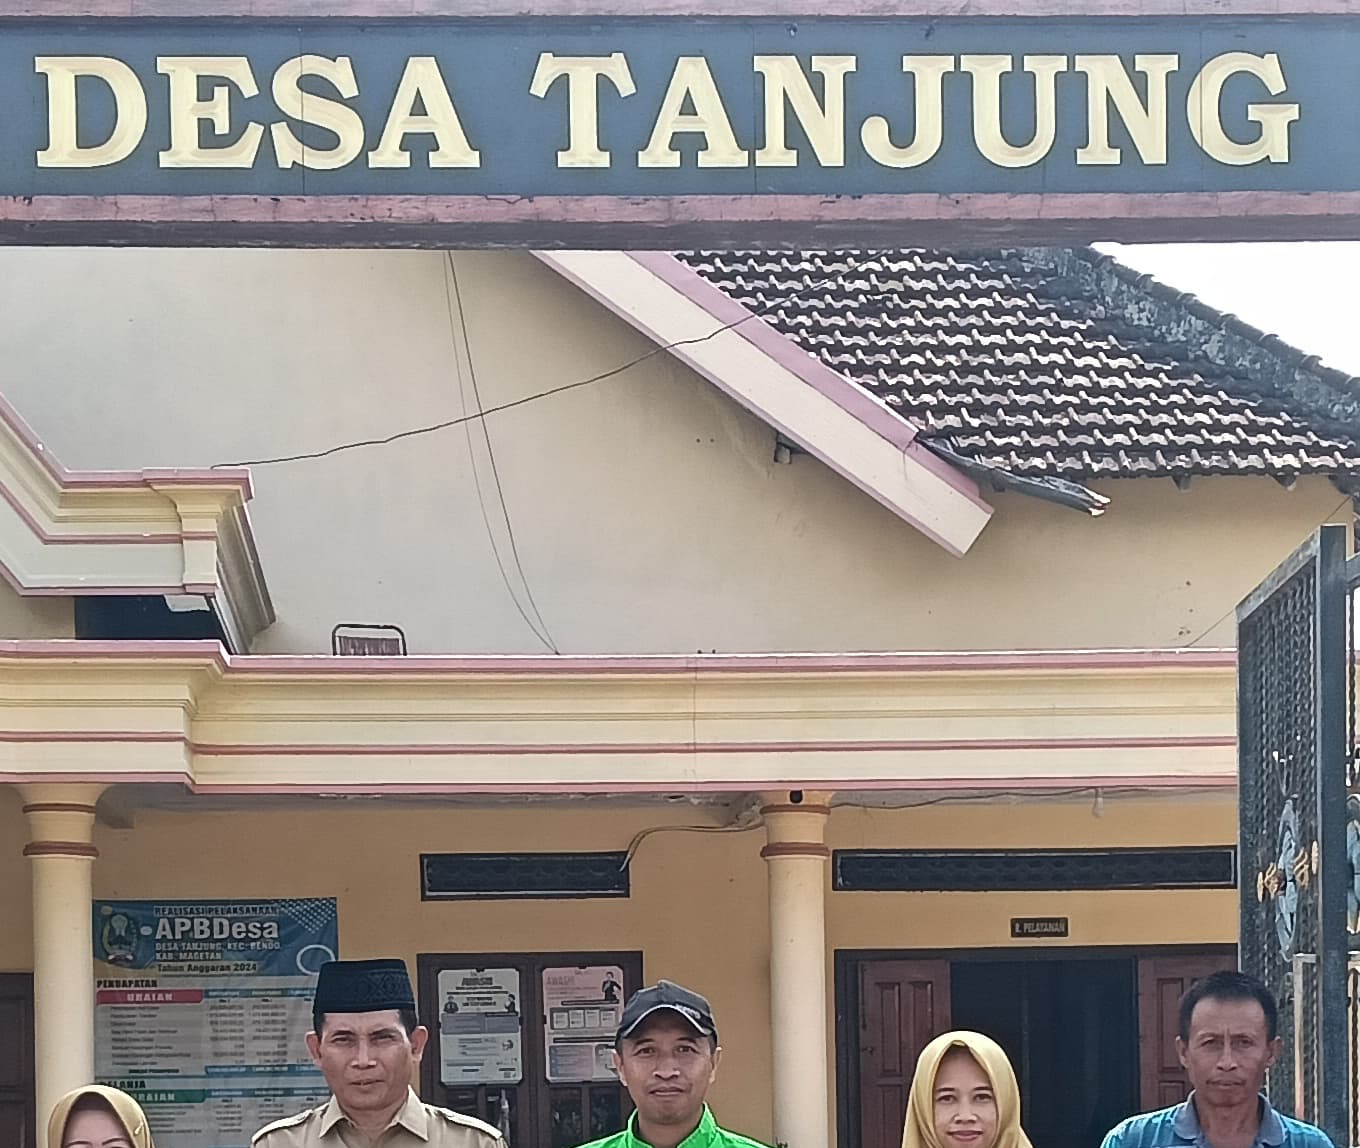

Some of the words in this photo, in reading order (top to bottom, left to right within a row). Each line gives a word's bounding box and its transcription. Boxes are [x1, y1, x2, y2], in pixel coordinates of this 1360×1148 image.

[36, 56, 481, 168] DESA
[529, 51, 1300, 168] TANJUNG
[155, 917, 278, 940] APBDesa
[155, 942, 179, 951] DESA
[179, 952, 222, 960] MAGETAN
[158, 963, 185, 972] Tahun
[187, 963, 231, 973] Anggaran
[233, 963, 257, 972] 2024
